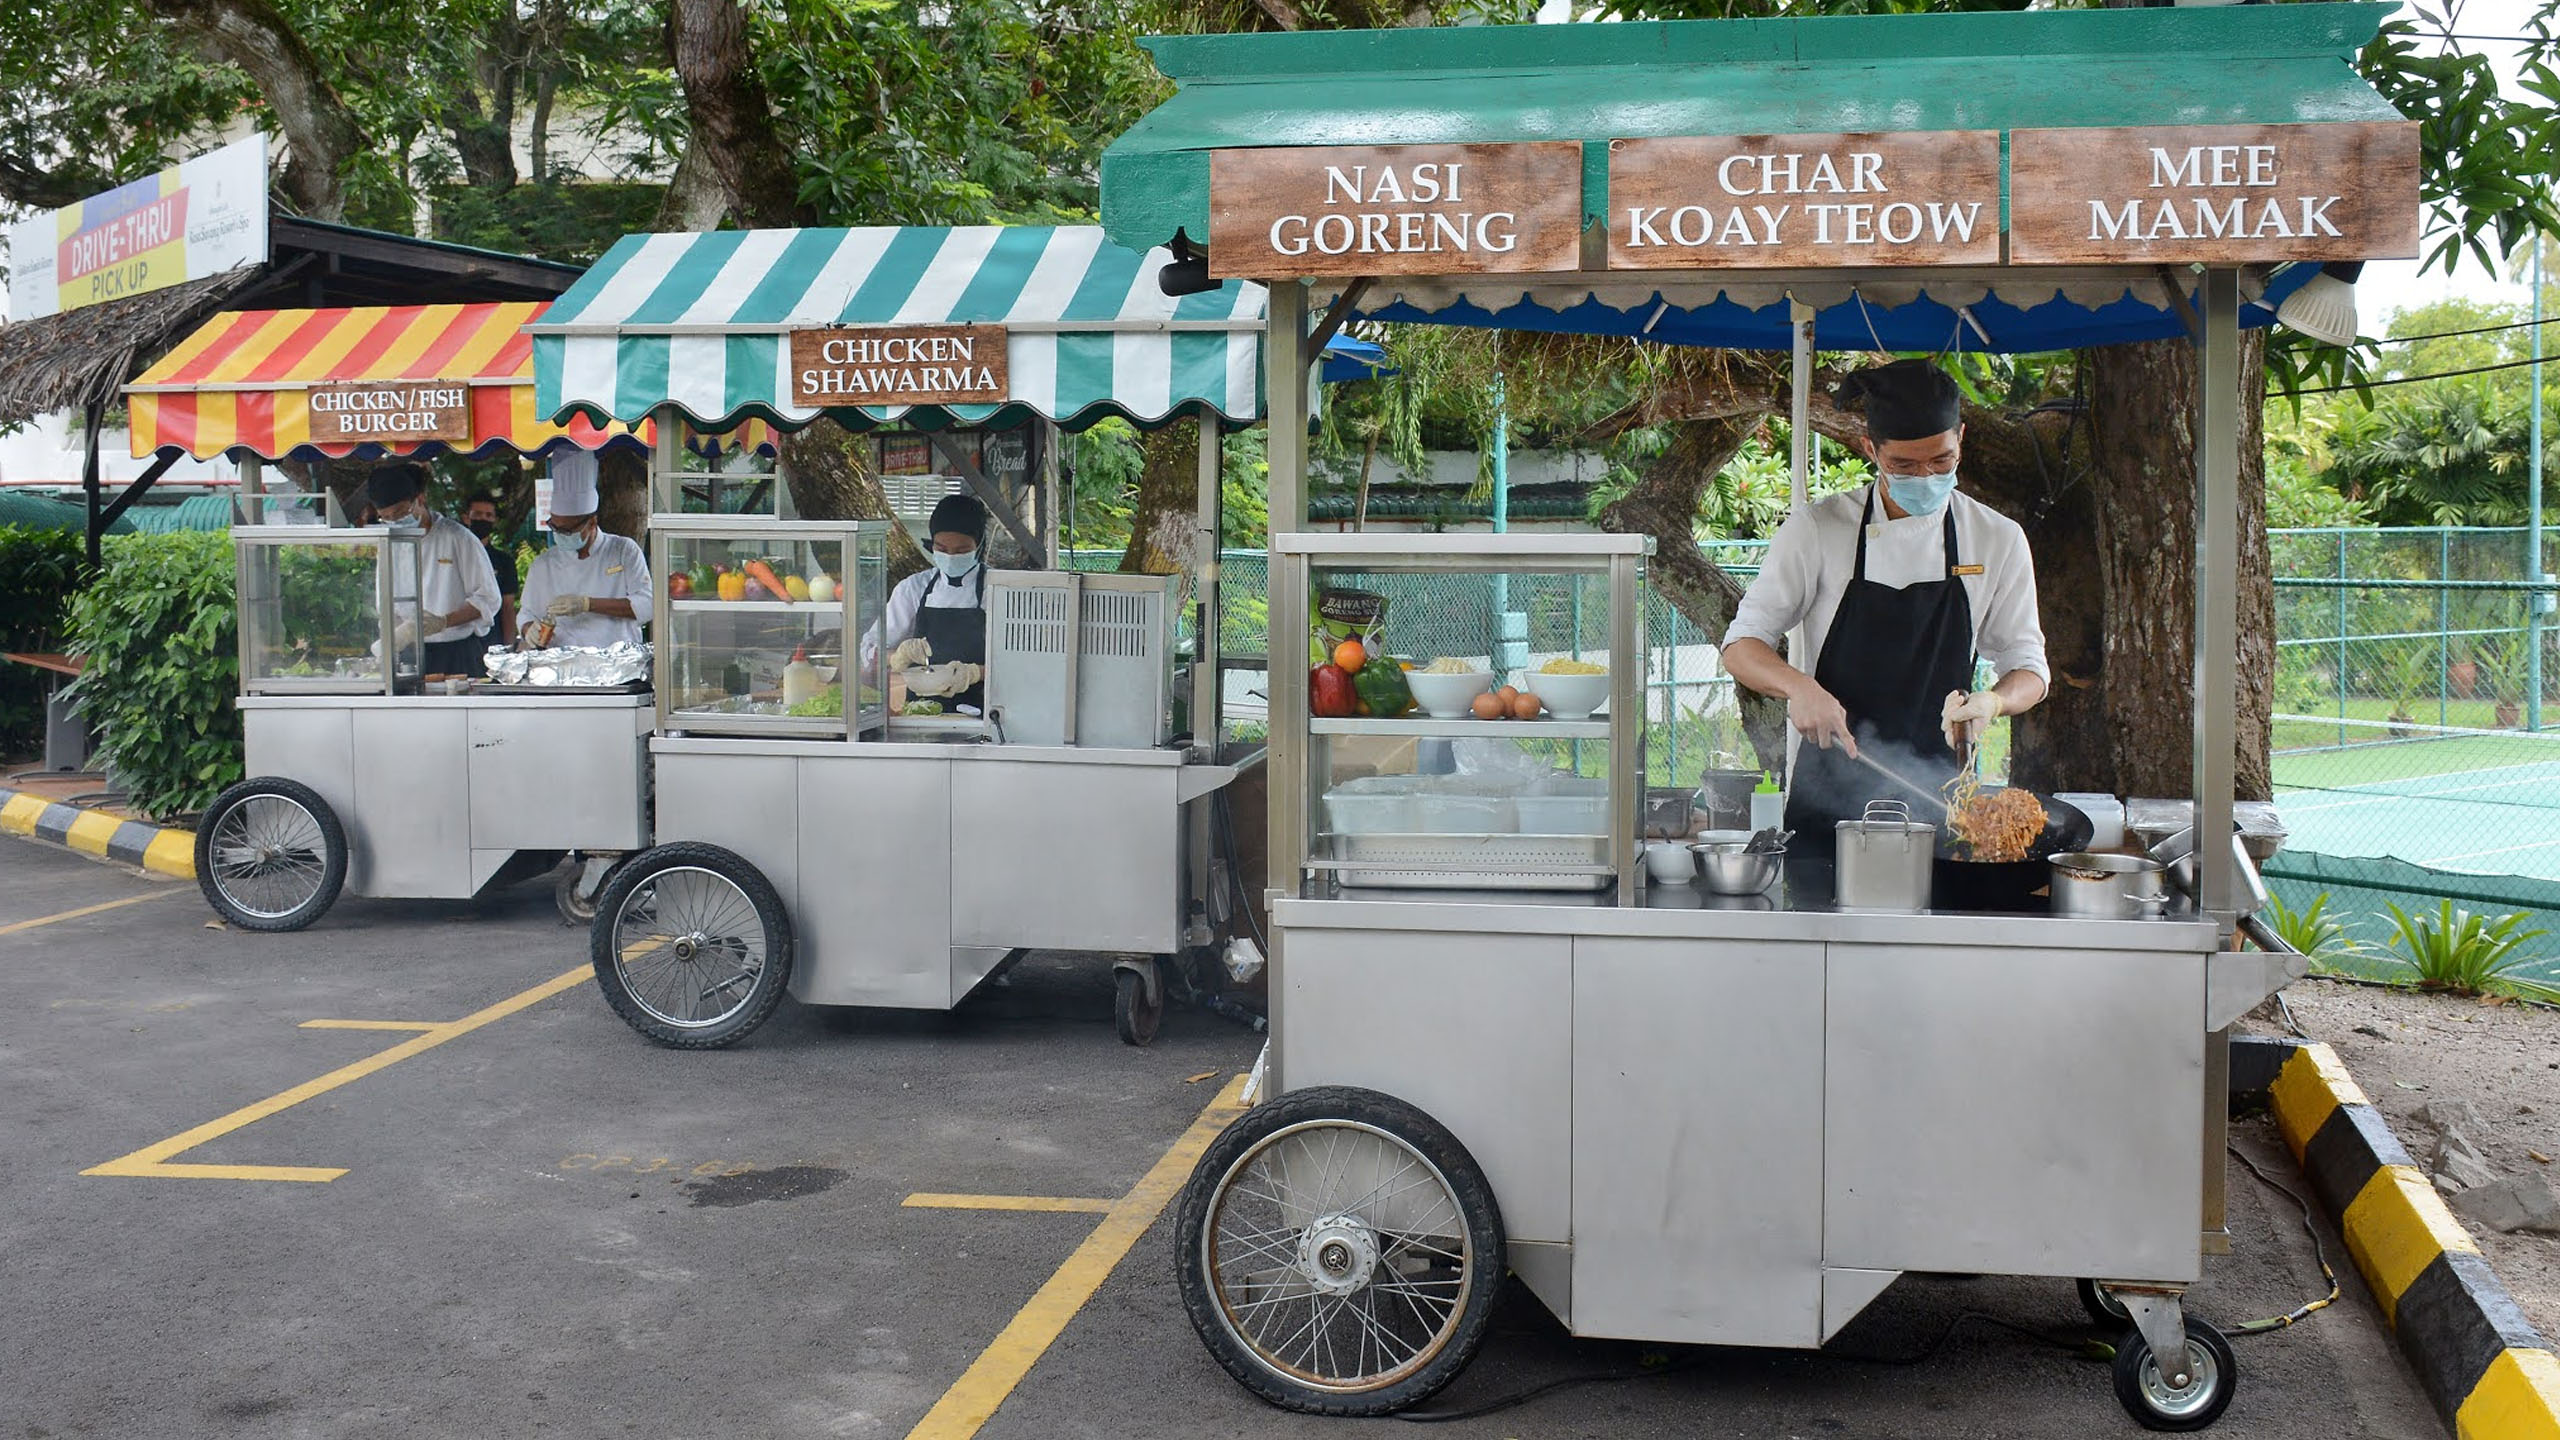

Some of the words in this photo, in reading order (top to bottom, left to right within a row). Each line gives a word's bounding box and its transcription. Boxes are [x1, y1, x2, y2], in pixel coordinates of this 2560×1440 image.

[1323, 163, 1463, 204] NASI
[1717, 152, 1889, 196] CHAR
[2148, 145, 2278, 188] MEE
[1269, 212, 1518, 256] GORENG
[1626, 204, 1791, 247] KOAY
[1804, 202, 1983, 245] TEOW
[2087, 195, 2343, 240] MAMAK
[72, 200, 172, 278] DRIVE-THRU
[92, 267, 124, 300] PICK
[128, 261, 148, 290] UP
[823, 336, 974, 364] CHICKEN
[802, 366, 999, 394] SHAWARMA
[339, 412, 438, 433] BURGER
[988, 447, 1027, 476] Bread
